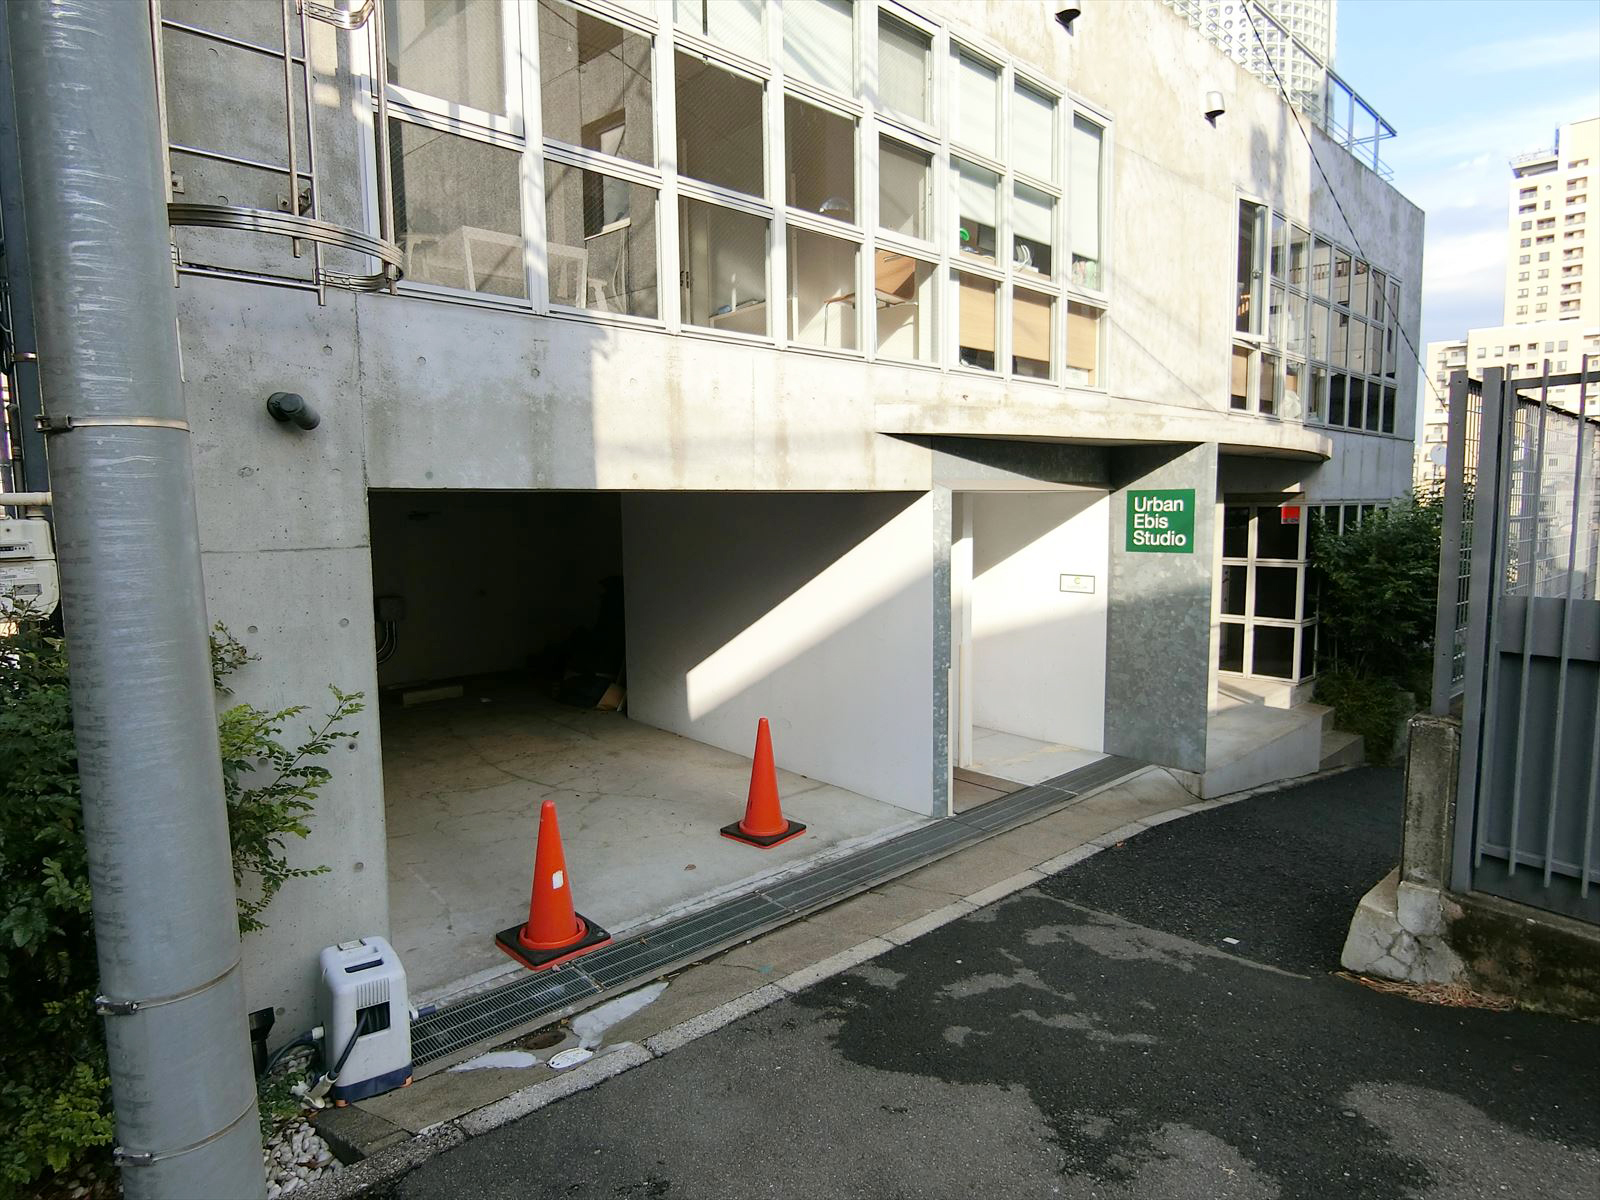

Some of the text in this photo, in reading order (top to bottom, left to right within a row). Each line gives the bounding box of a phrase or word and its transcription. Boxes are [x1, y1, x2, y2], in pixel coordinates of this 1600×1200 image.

[1134, 496, 1184, 512] Urban
[1133, 513, 1168, 529] Ebis
[1132, 530, 1187, 546] Studio
